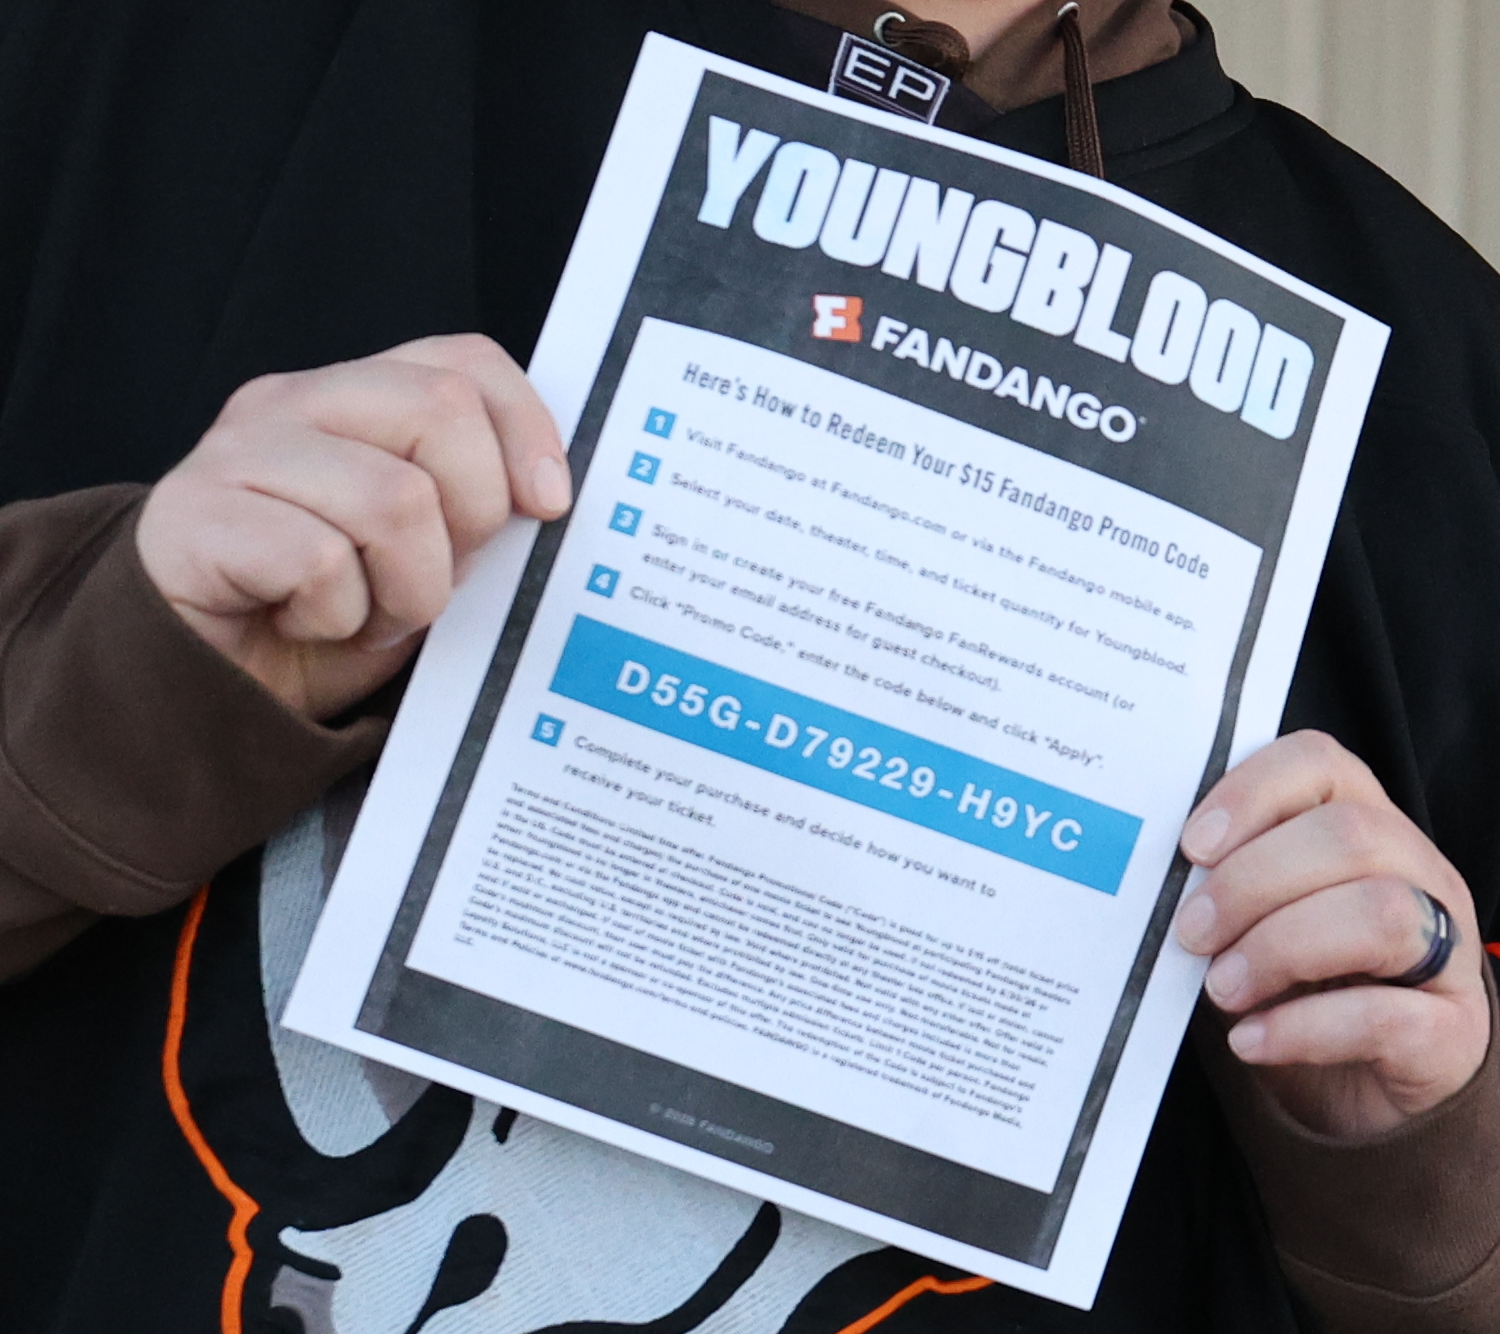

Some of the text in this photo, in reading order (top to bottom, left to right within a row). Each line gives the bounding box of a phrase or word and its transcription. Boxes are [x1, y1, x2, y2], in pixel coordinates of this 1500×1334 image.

[842, 45, 938, 103] EP
[696, 114, 1314, 440] YOUNGBLOOD
[870, 315, 1137, 443] FANDANGO
[654, 414, 666, 431] 1
[635, 457, 652, 476] 2
[680, 360, 1210, 580] Here's How to Redeem Your $15 Fandango Promo Code
[616, 509, 634, 528] 3
[594, 572, 611, 589] 4
[540, 720, 554, 739] 5
[616, 659, 1082, 851] D55G-D79229-H9YC
